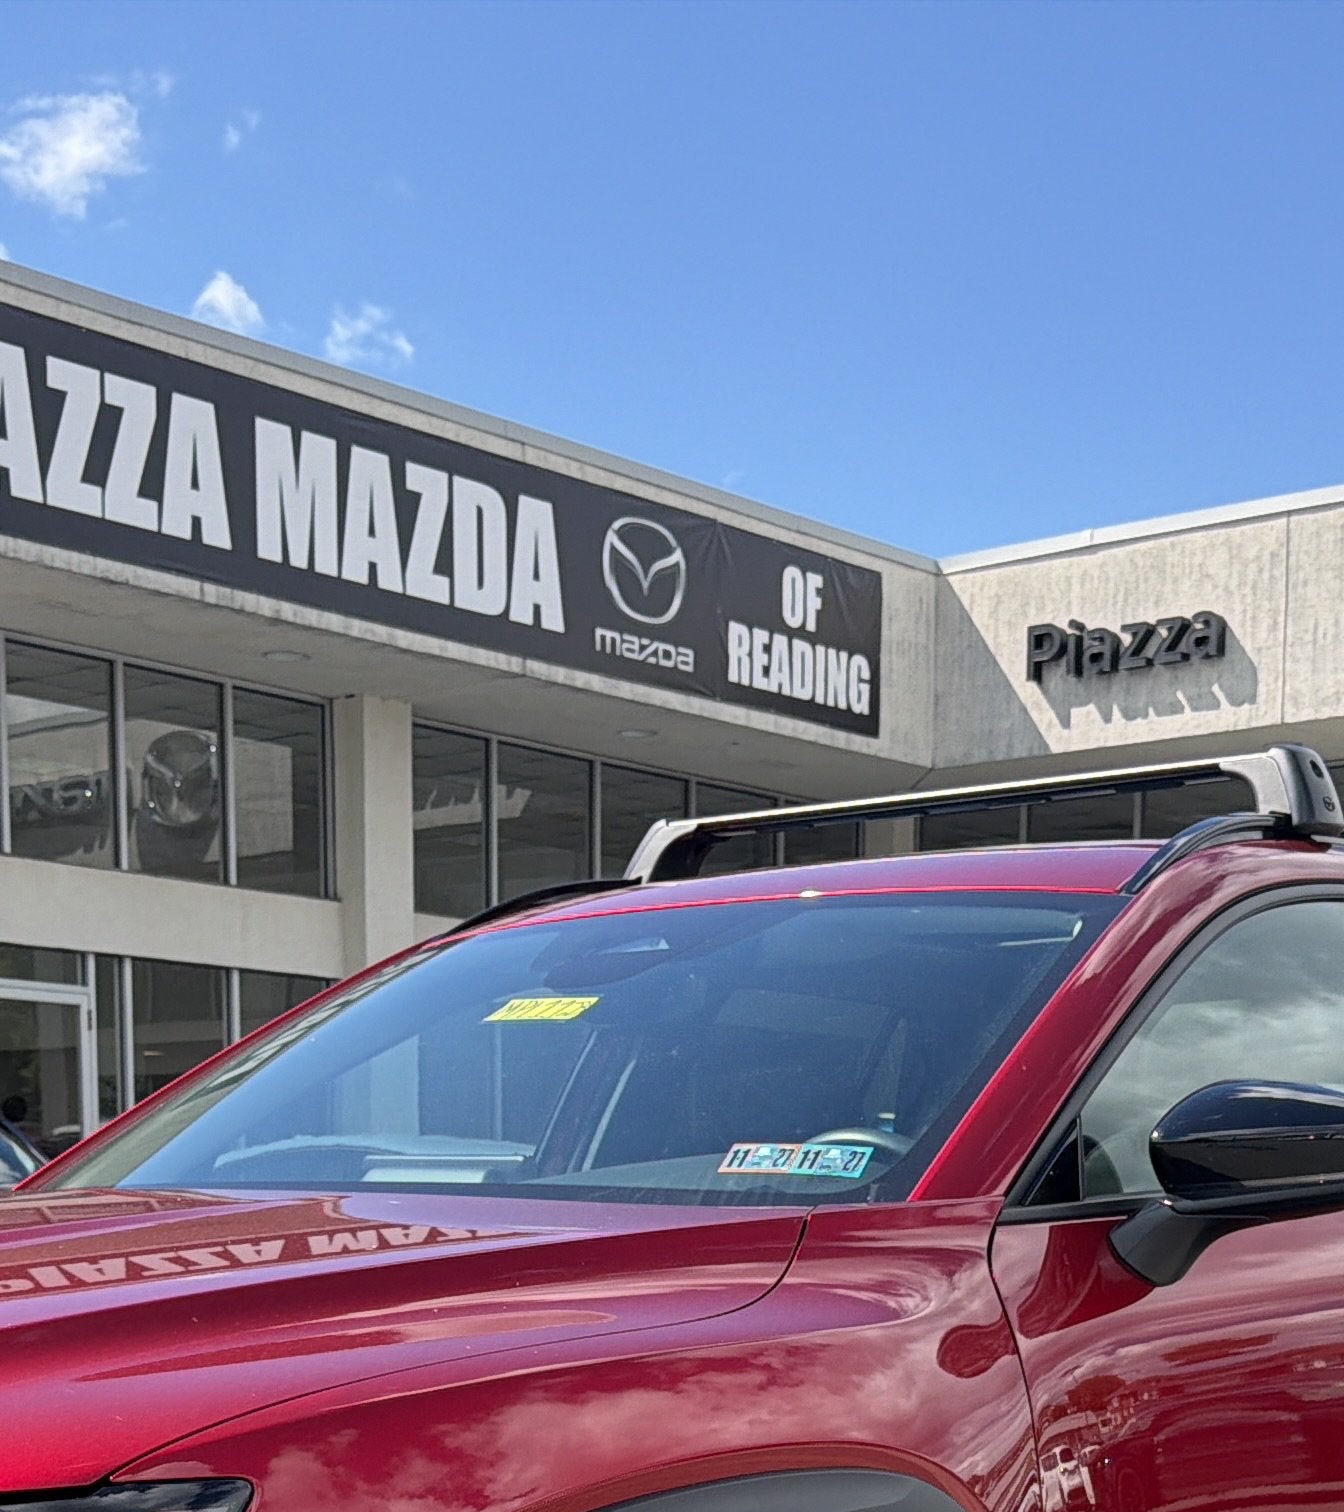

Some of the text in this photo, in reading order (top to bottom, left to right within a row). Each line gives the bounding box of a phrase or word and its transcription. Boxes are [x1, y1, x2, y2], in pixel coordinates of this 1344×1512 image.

[255, 416, 566, 634] MAZDA
[781, 565, 824, 633] OF
[594, 626, 695, 673] mazda
[727, 620, 871, 716] READING
[1026, 609, 1227, 684] Piazza
[772, 1148, 796, 1168] 27
[842, 1150, 867, 1172] 27
